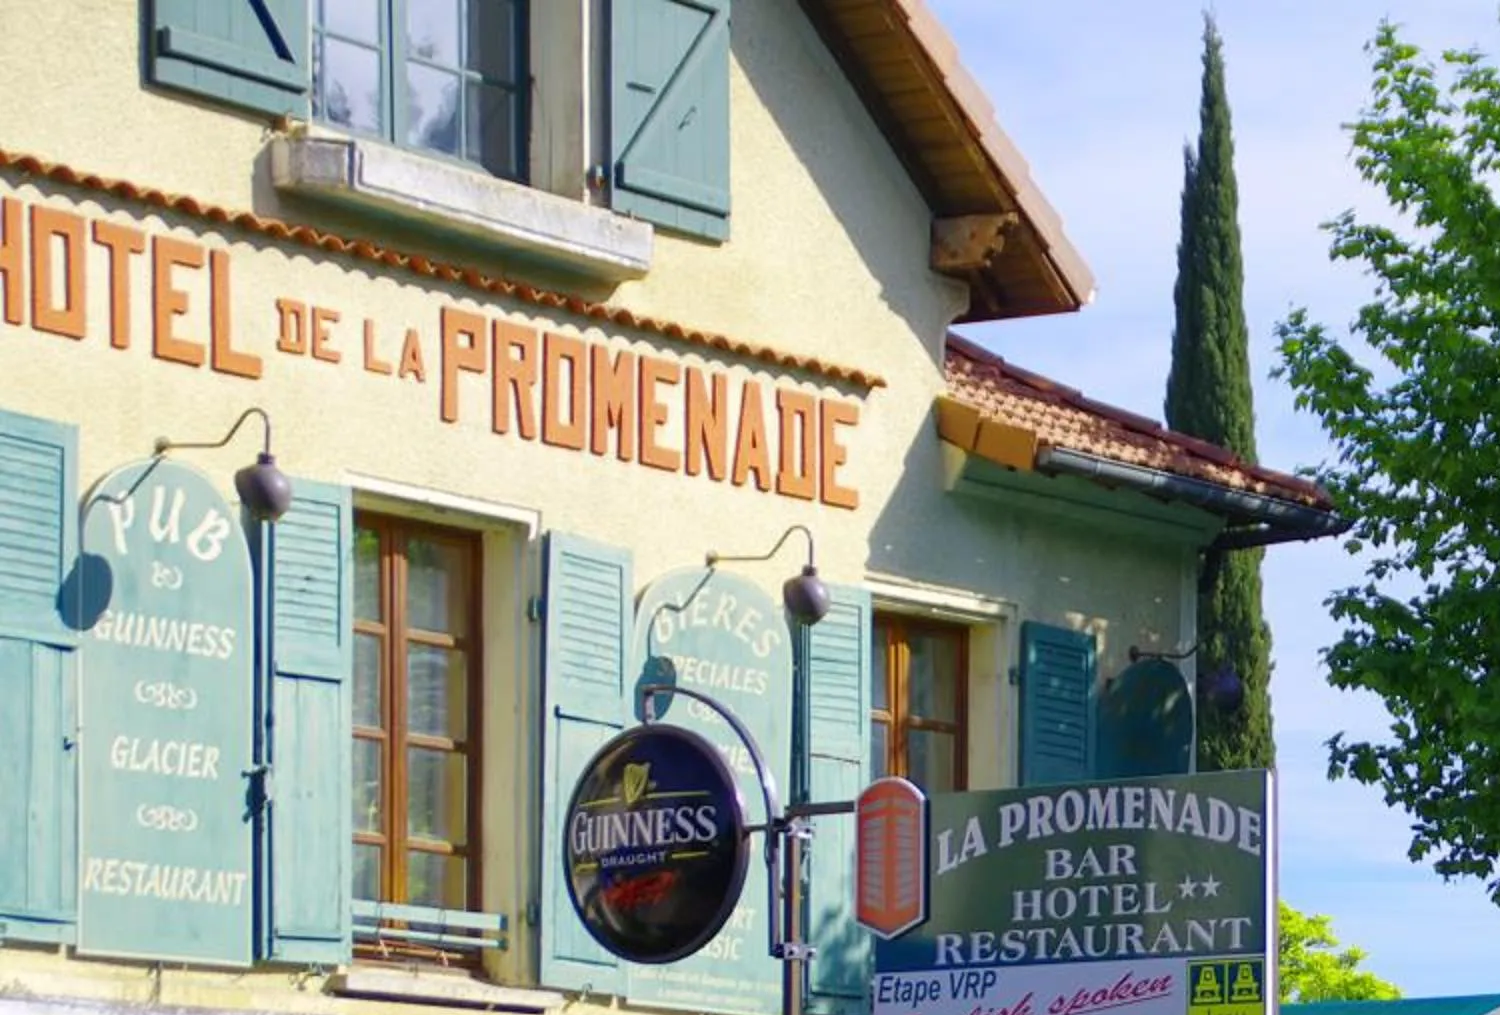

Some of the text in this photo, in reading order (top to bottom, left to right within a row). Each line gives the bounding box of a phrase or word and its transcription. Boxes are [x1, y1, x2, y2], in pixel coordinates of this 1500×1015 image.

[276, 298, 341, 363] DE
[364, 318, 425, 382] LA
[441, 306, 859, 509] PROMENADE
[108, 485, 231, 561] PUB
[94, 609, 236, 660] GUINNESS
[111, 736, 220, 780] GLACIER
[572, 805, 717, 855] GUINNESS
[936, 787, 1262, 876] LA PROMENADE
[84, 857, 247, 906] RESTAURANT
[602, 851, 667, 867] DRAUGHT
[1045, 844, 1137, 881] BAR
[1012, 881, 1172, 922] HOTEL
[935, 917, 1251, 966] RESTAURANT
[878, 970, 997, 1008] Etape VRP
